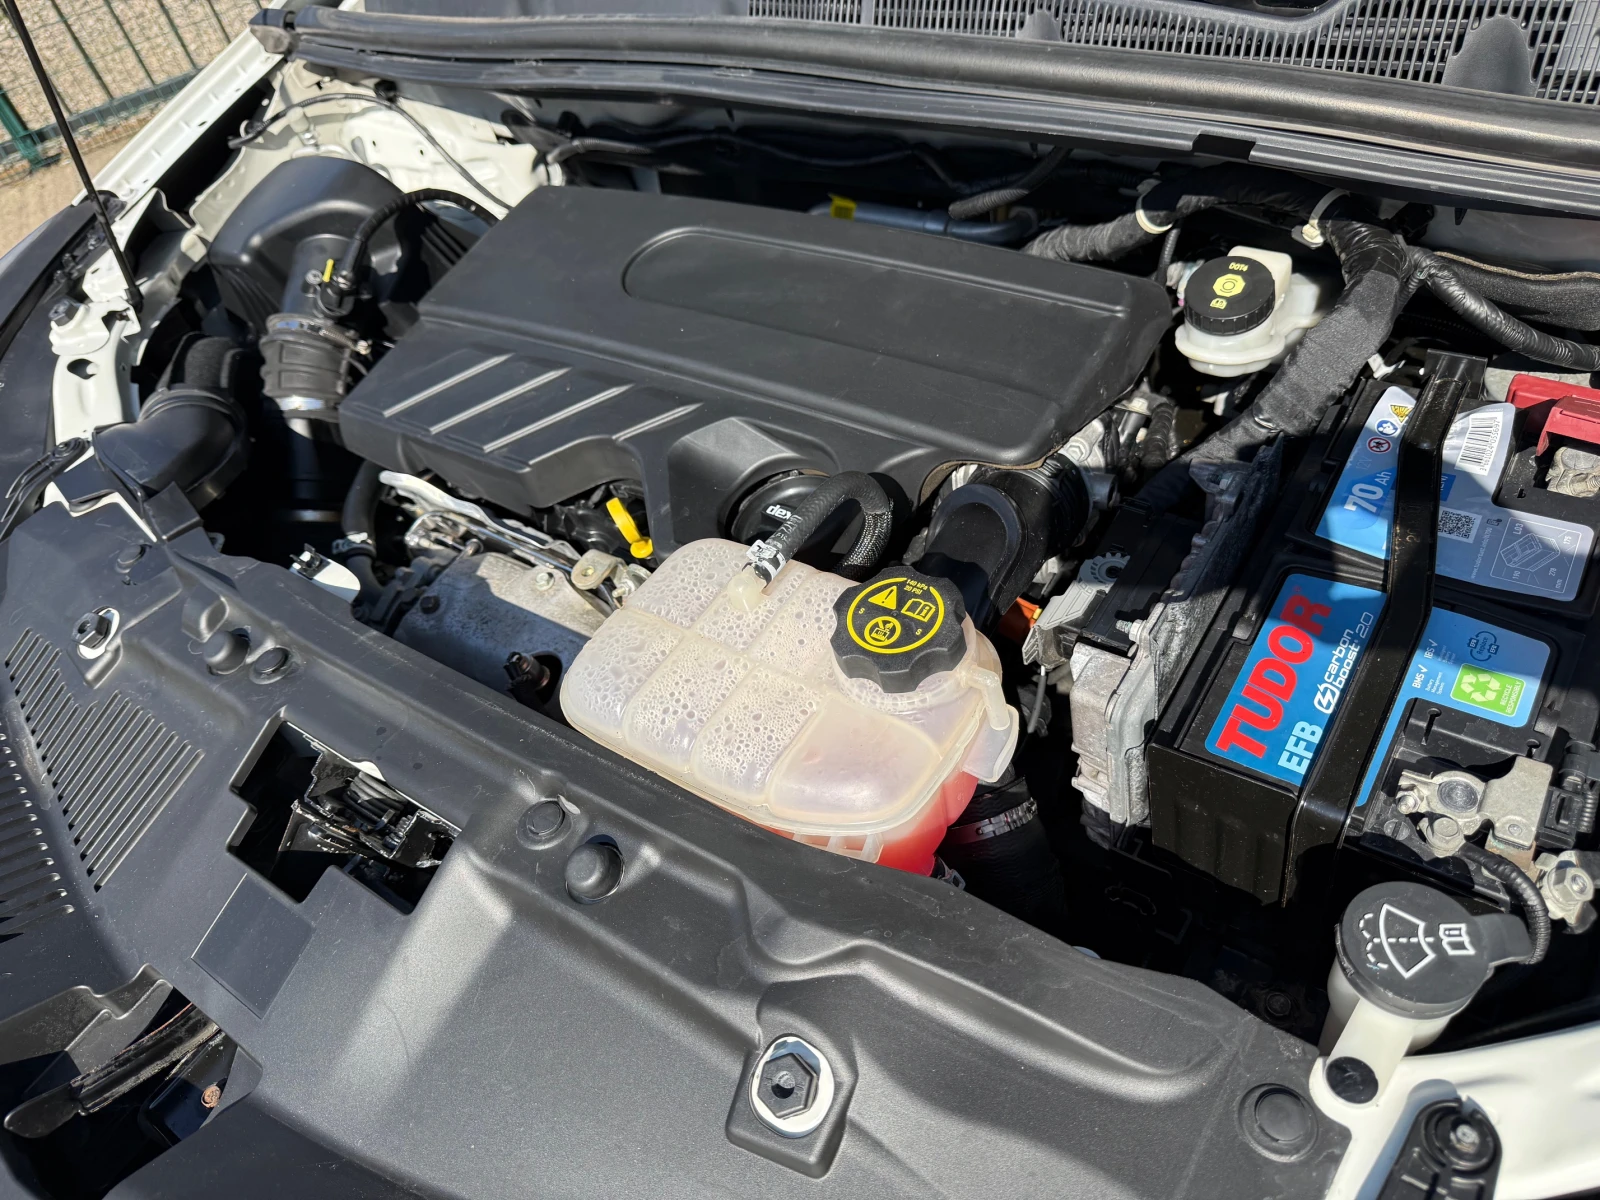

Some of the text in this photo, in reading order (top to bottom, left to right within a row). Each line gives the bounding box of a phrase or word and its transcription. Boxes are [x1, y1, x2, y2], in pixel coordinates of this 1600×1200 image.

[1229, 262, 1249, 272] DOT4
[1344, 471, 1392, 513] 70 Ah
[1563, 535, 1572, 545] 175
[903, 584, 923, 595] 20 PSI
[906, 579, 928, 591] 140 kPa
[1355, 611, 1374, 639] 2.0
[1324, 628, 1353, 683] carbon
[1424, 647, 1435, 659] IBS
[1216, 594, 1332, 759] TUDOR
[1412, 673, 1425, 689] BMS
[1500, 684, 1512, 706] RECYCLE
[1506, 681, 1522, 713] RESPONSIBLY
[1278, 721, 1323, 775] EFB
